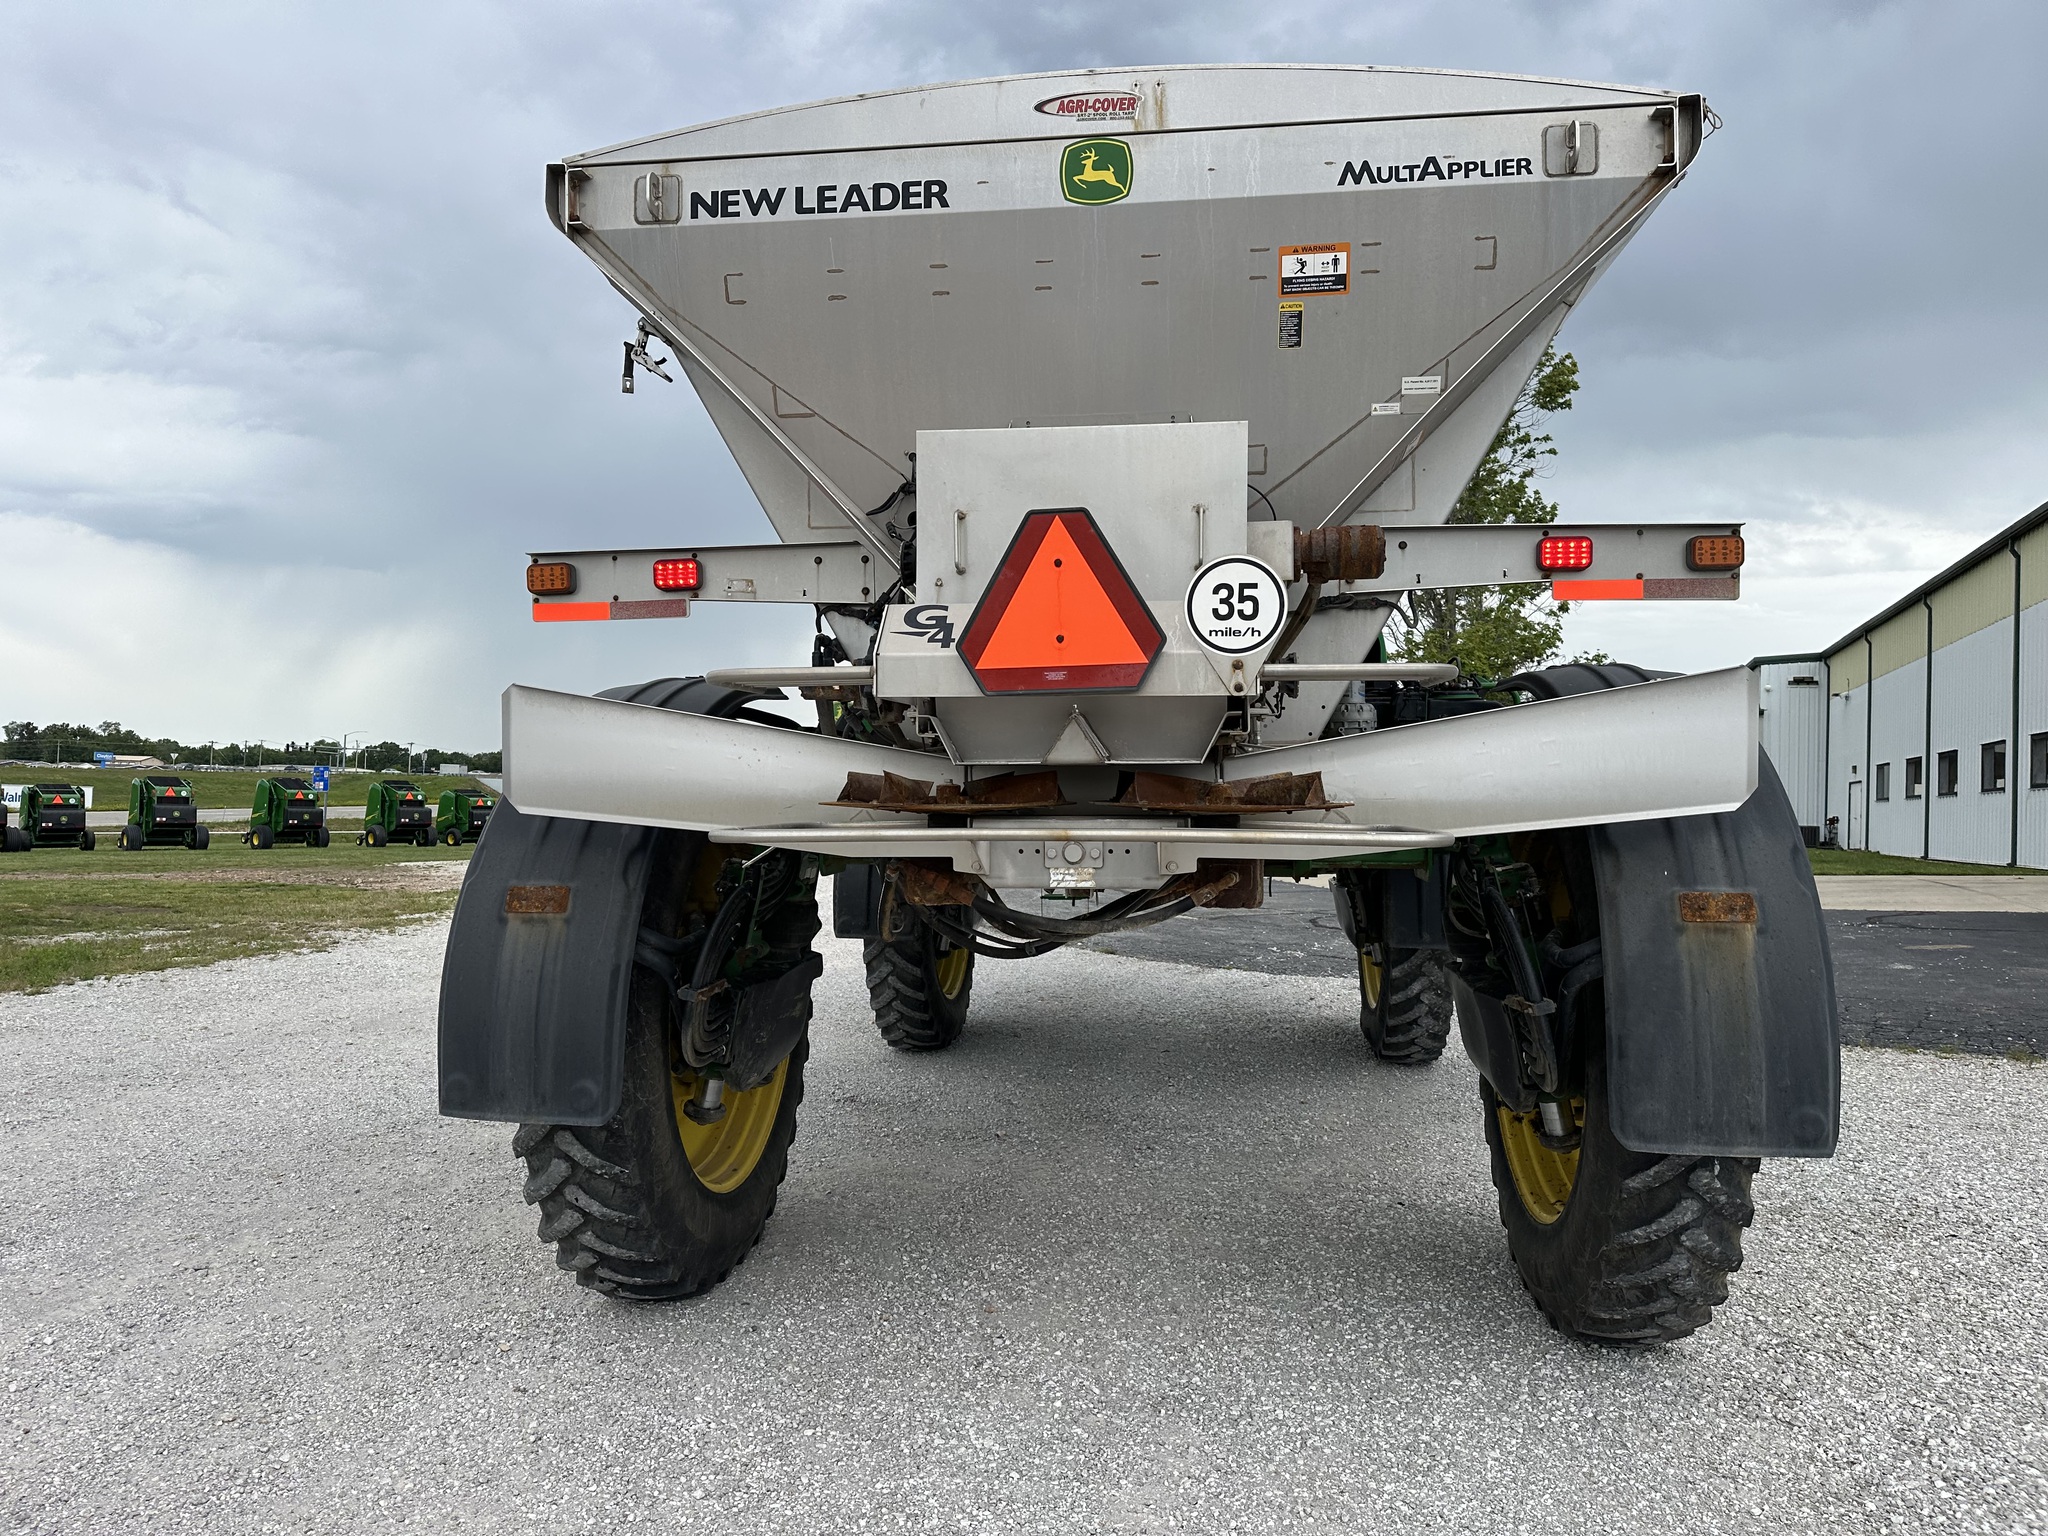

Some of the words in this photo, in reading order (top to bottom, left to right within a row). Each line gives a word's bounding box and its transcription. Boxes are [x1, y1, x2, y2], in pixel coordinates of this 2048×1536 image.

[1056, 97, 1137, 114] AGRI-COVER
[690, 187, 787, 219] NEW
[794, 179, 950, 215] LEADER
[1301, 244, 1336, 252] WARNING
[1212, 582, 1259, 621] 35
[904, 604, 956, 648] G4
[1208, 627, 1261, 637] mile/h
